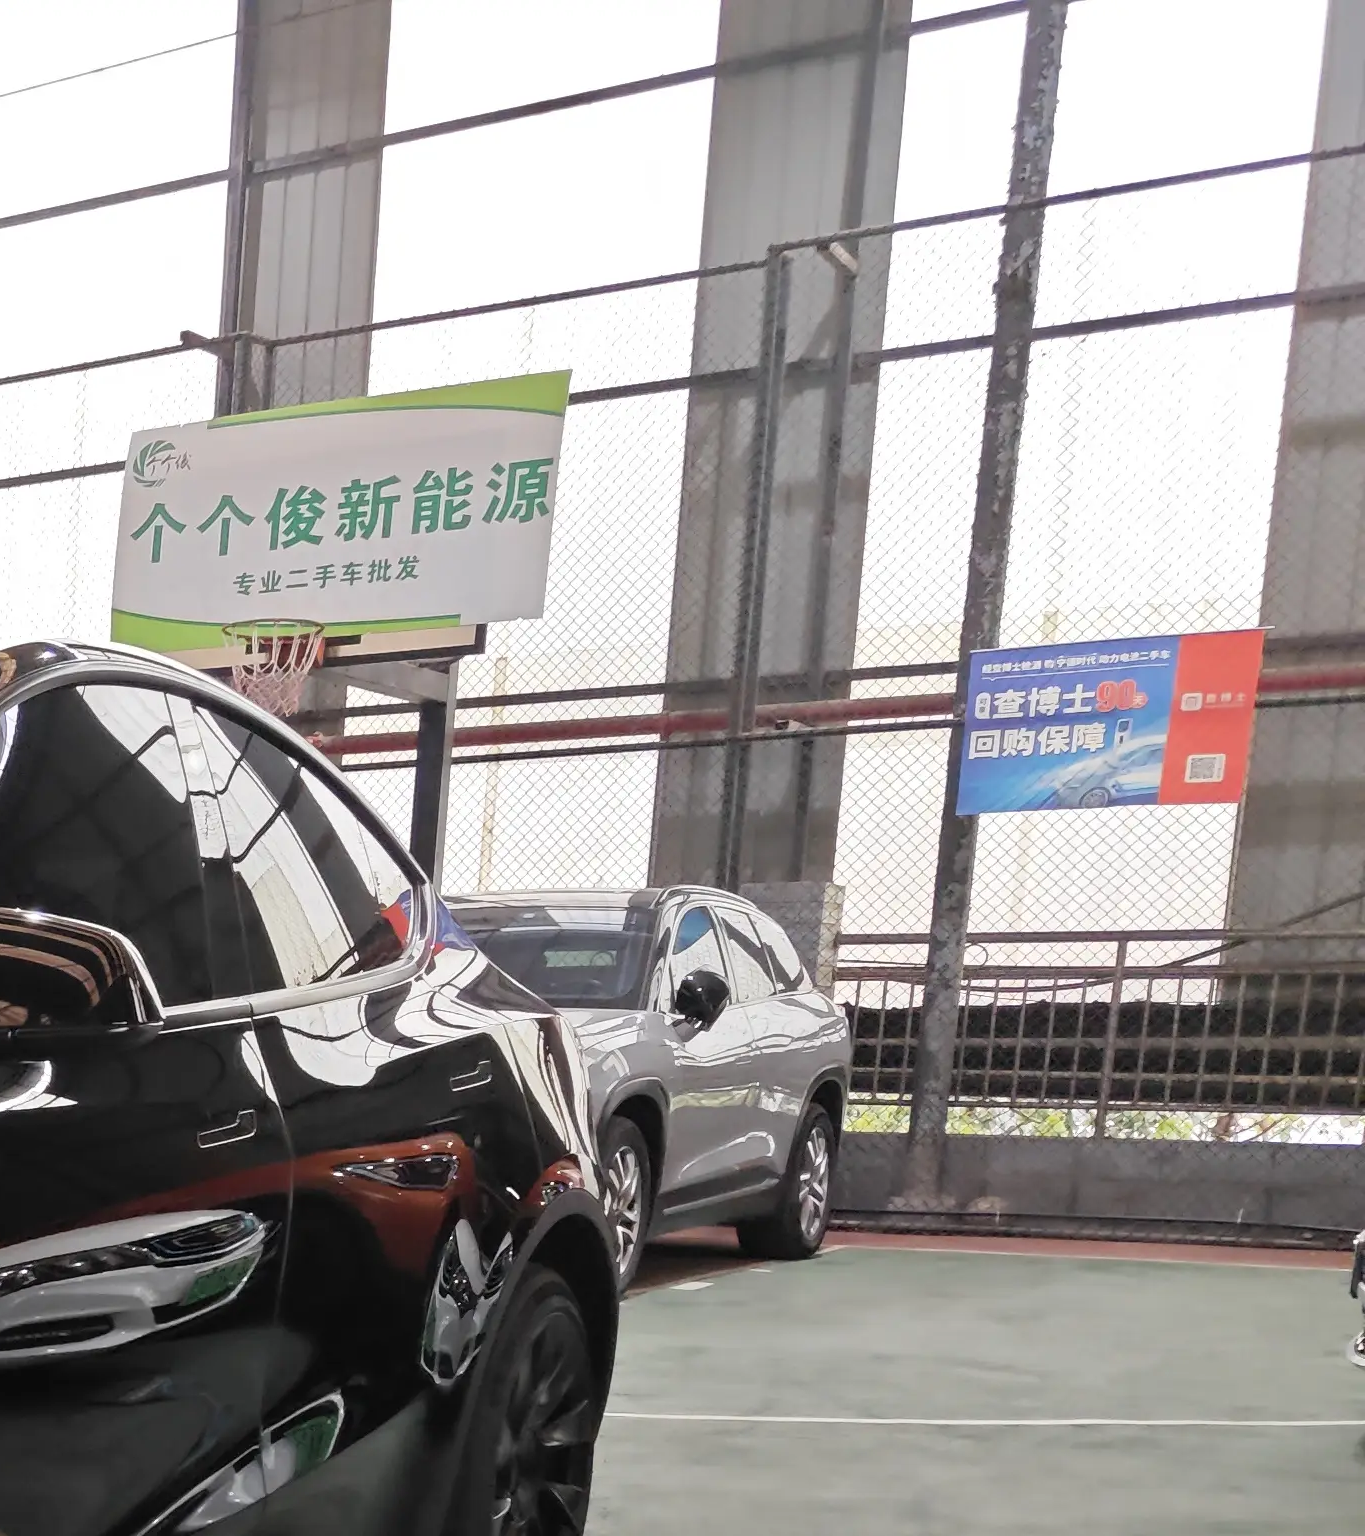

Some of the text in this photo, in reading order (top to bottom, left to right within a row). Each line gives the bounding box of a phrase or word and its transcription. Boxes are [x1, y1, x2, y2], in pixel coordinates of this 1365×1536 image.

[130, 456, 555, 564] 个个俊新能源
[231, 555, 422, 597] 专业二手车批发
[968, 722, 1107, 760] 回购保障
